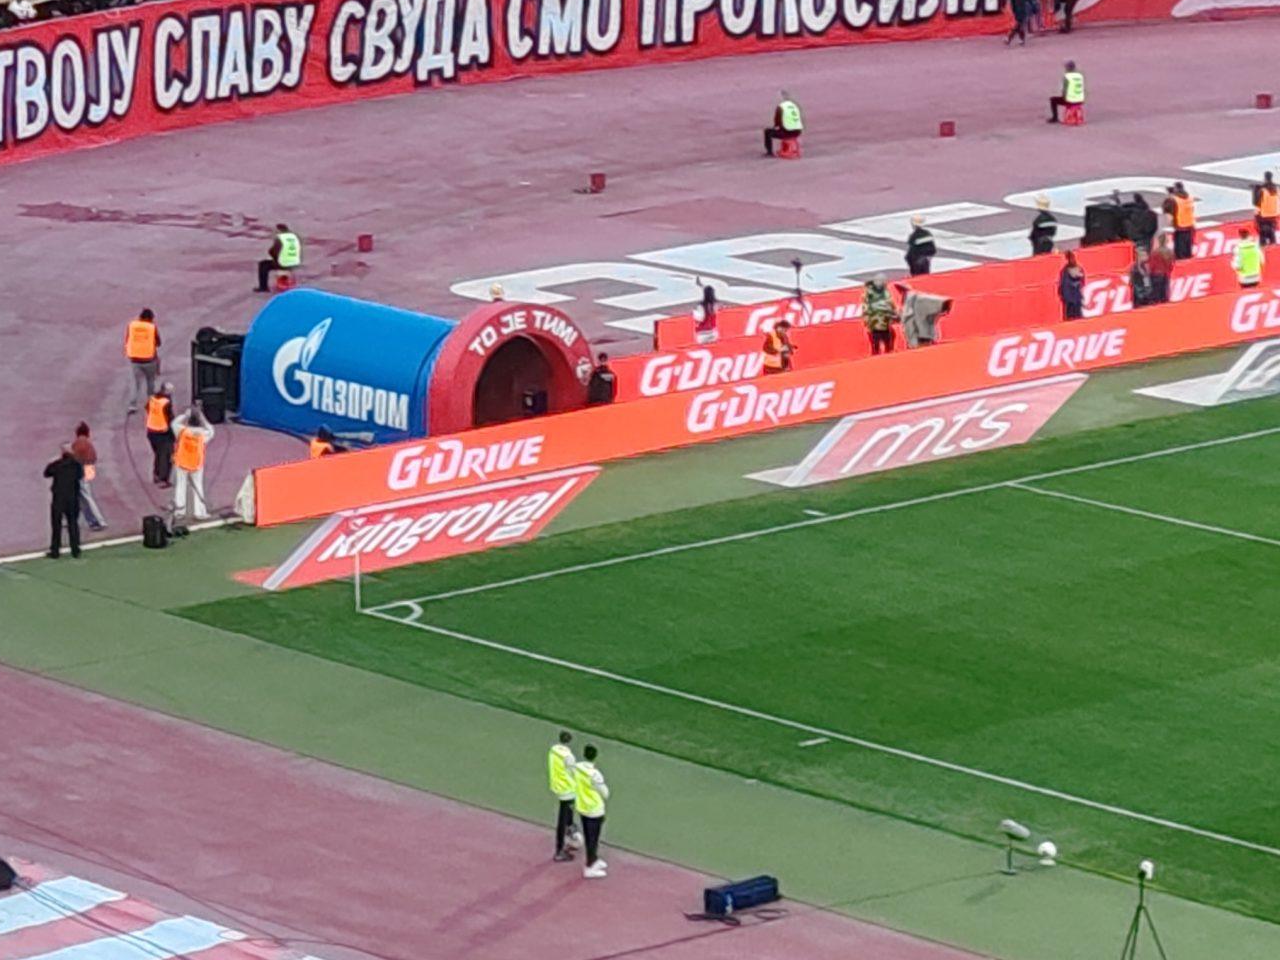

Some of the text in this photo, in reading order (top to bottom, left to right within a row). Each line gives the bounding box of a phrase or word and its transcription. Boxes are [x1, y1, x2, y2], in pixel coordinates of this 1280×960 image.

[154, 3, 315, 109] СЛАВУ
[468, 325, 498, 356] ТО
[500, 310, 528, 334] ЈЕ
[311, 373, 409, 431] ГАЗПРОМ
[839, 398, 1027, 475] mts
